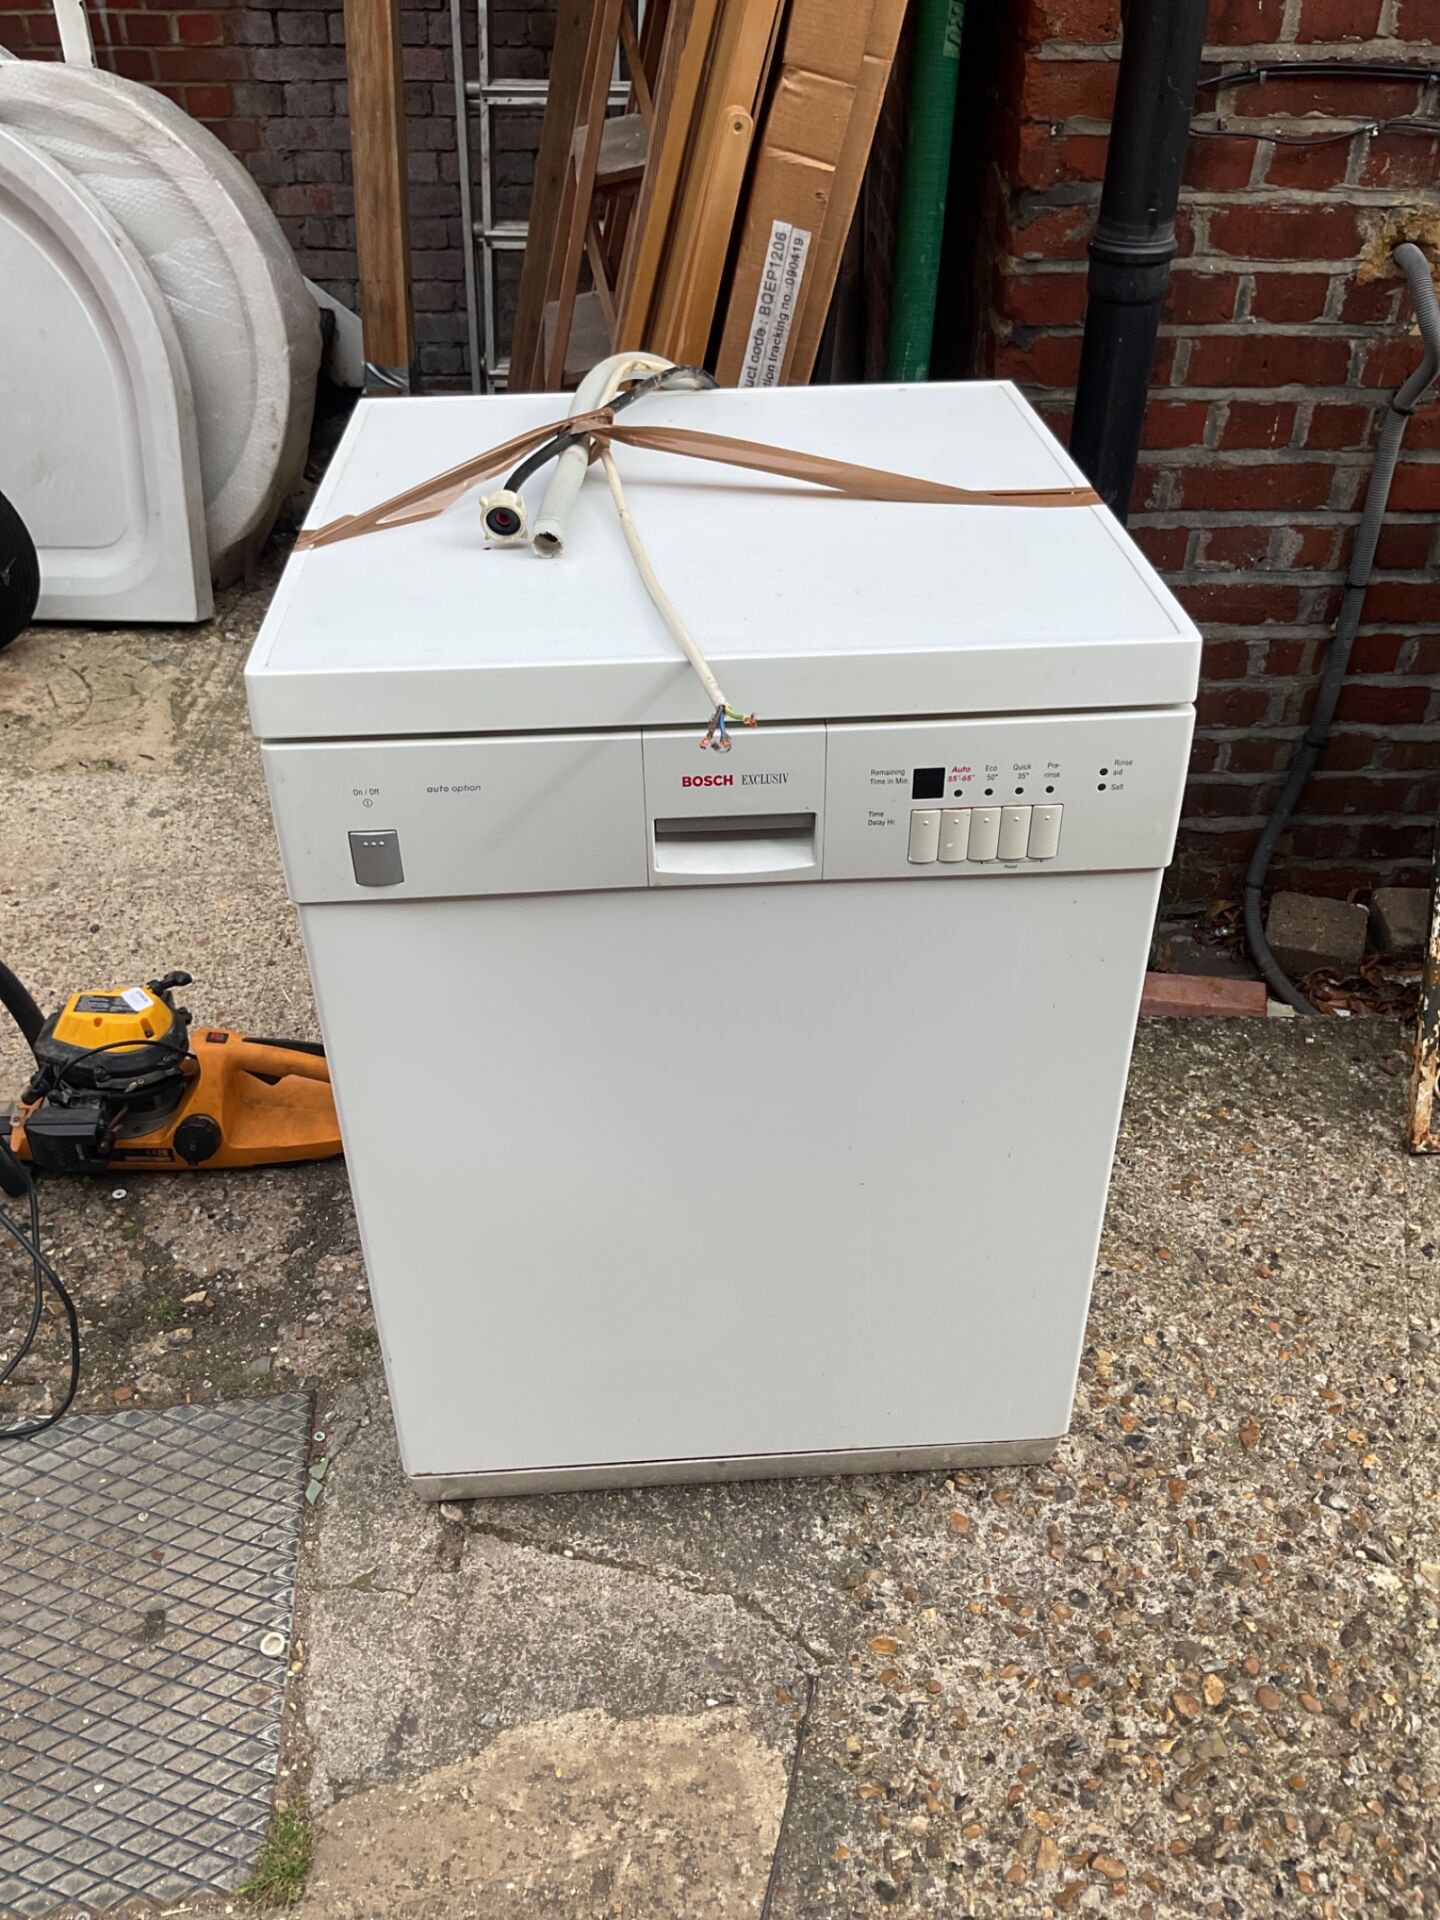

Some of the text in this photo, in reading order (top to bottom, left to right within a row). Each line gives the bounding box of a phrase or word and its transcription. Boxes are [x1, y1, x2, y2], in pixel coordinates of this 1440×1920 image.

[758, 232, 787, 317] BQEP1206
[768, 313, 790, 362] tracking
[751, 329, 766, 363] code
[985, 764, 998, 772] Eco
[1013, 763, 1032, 771] Quick
[870, 768, 905, 777] Remaining
[681, 772, 790, 788] BOSCH EXCLUSIV
[426, 784, 482, 794] auto option
[867, 819, 885, 828] Delay
